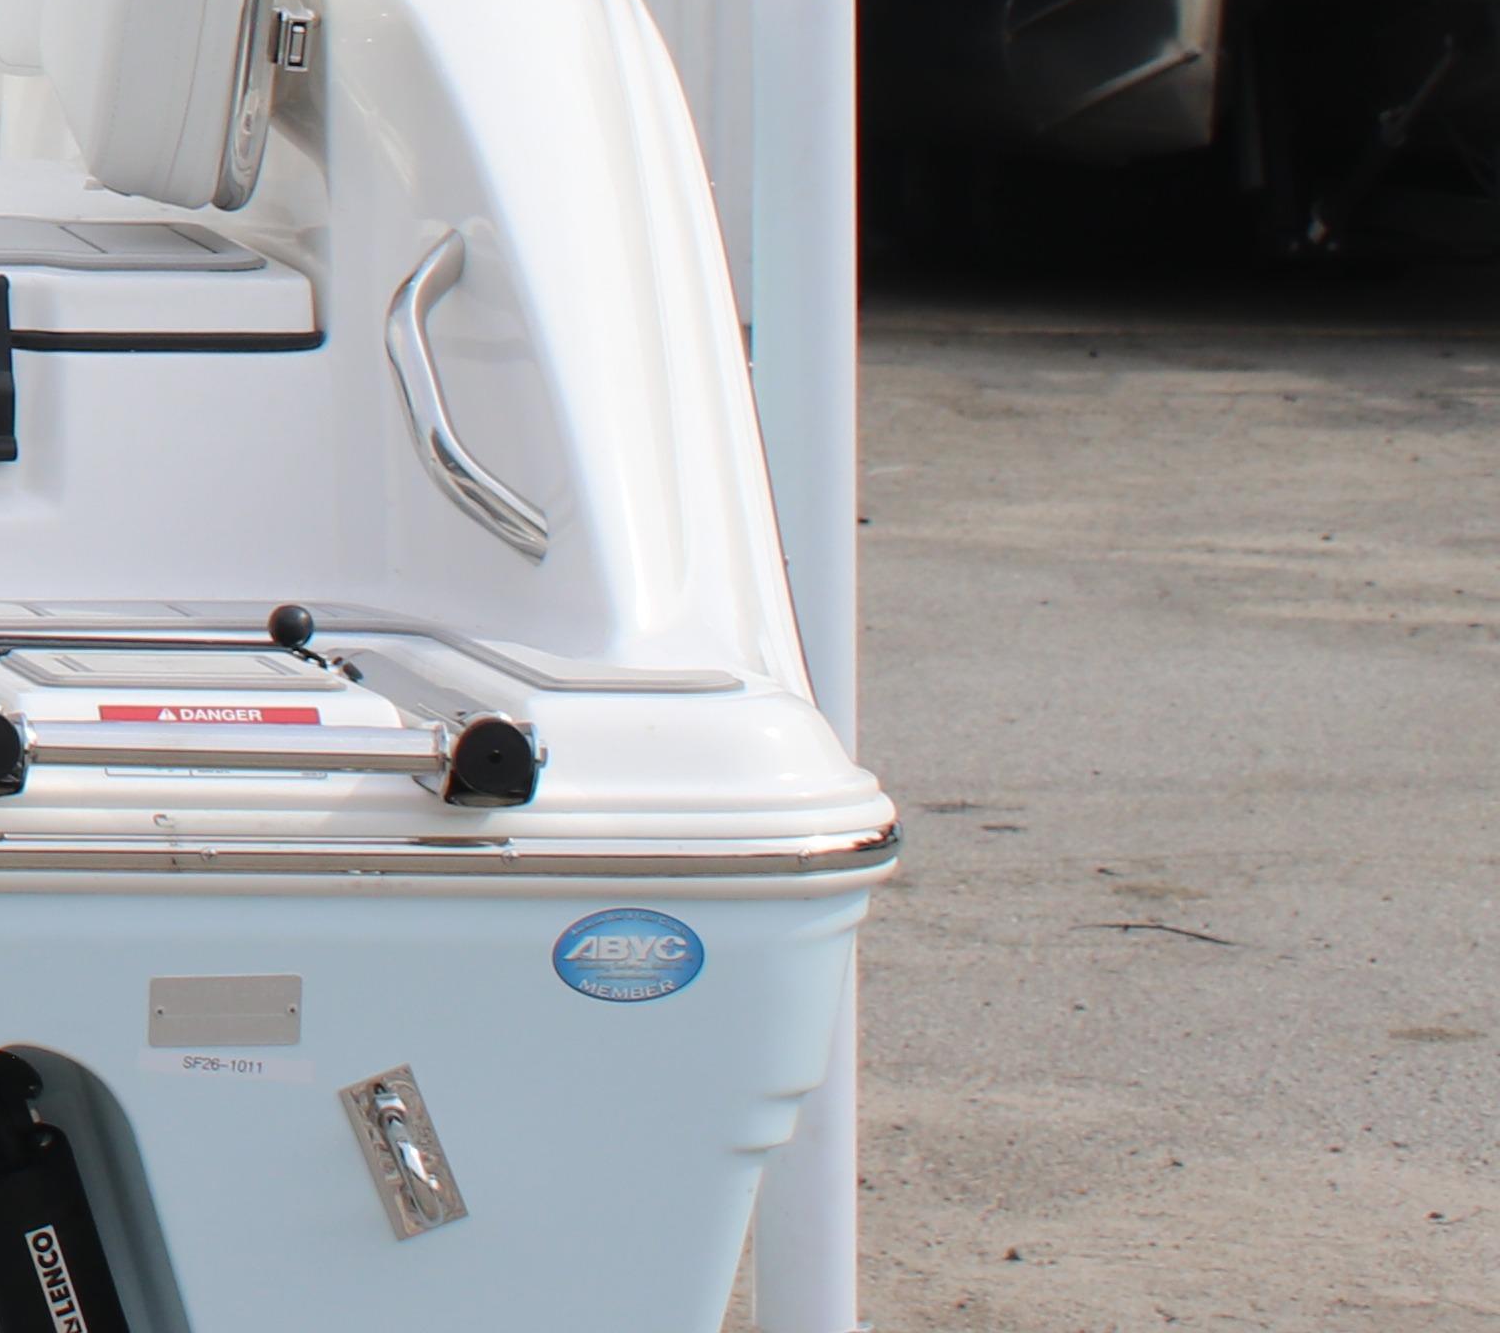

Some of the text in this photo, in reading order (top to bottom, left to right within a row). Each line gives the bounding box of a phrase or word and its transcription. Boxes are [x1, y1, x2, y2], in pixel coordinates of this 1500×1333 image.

[180, 709, 263, 722] DANGER
[563, 935, 687, 961] ABYC
[578, 979, 676, 999] MEMBER
[183, 1055, 263, 1073] SF26-1011
[32, 1231, 75, 1317] LENCO
